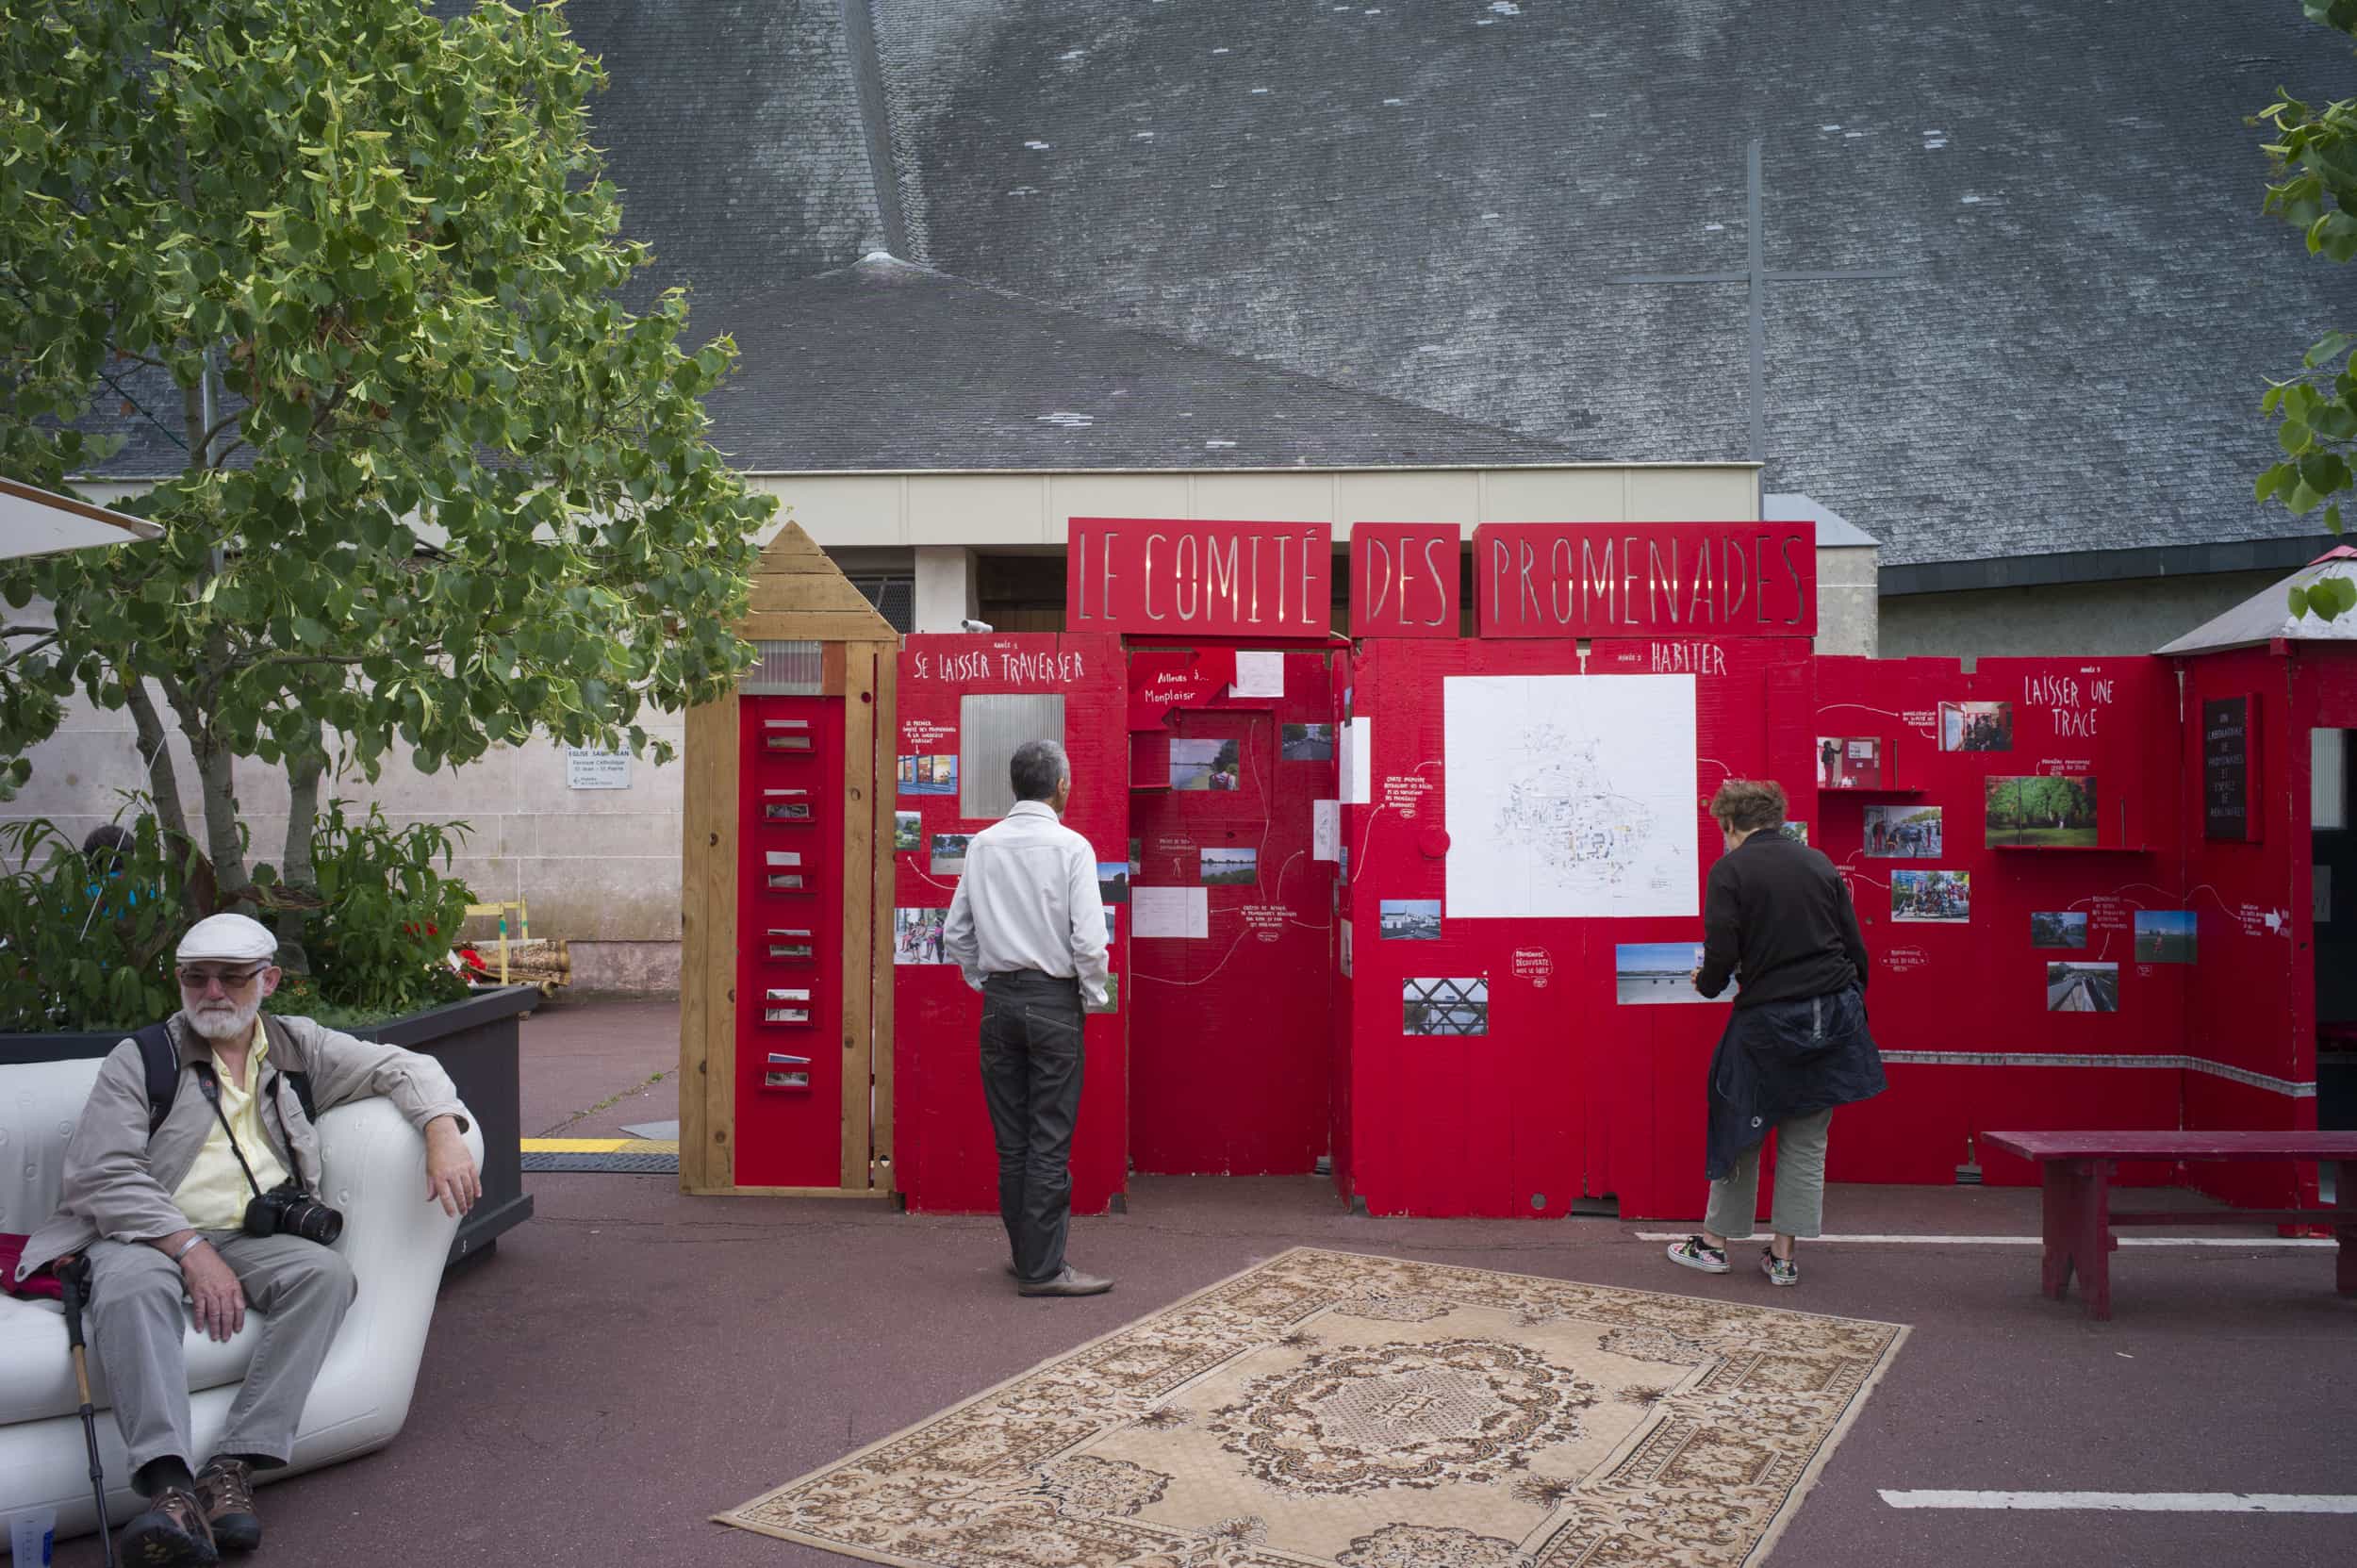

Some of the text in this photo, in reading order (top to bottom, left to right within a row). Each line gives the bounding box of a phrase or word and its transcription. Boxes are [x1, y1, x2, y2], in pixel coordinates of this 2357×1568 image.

[1079, 527, 1318, 624] LE COMITÉ
[1366, 536, 1446, 626] DES
[1493, 536, 1805, 625] PROMENADES
[914, 651, 1084, 685] SE LAISSER TRAVERSER
[1652, 639, 1727, 676] HABITER
[1145, 688, 1196, 705] Monplaisir
[2024, 670, 2115, 709] LAISSER UNE
[2052, 708, 2097, 737] TRACE
